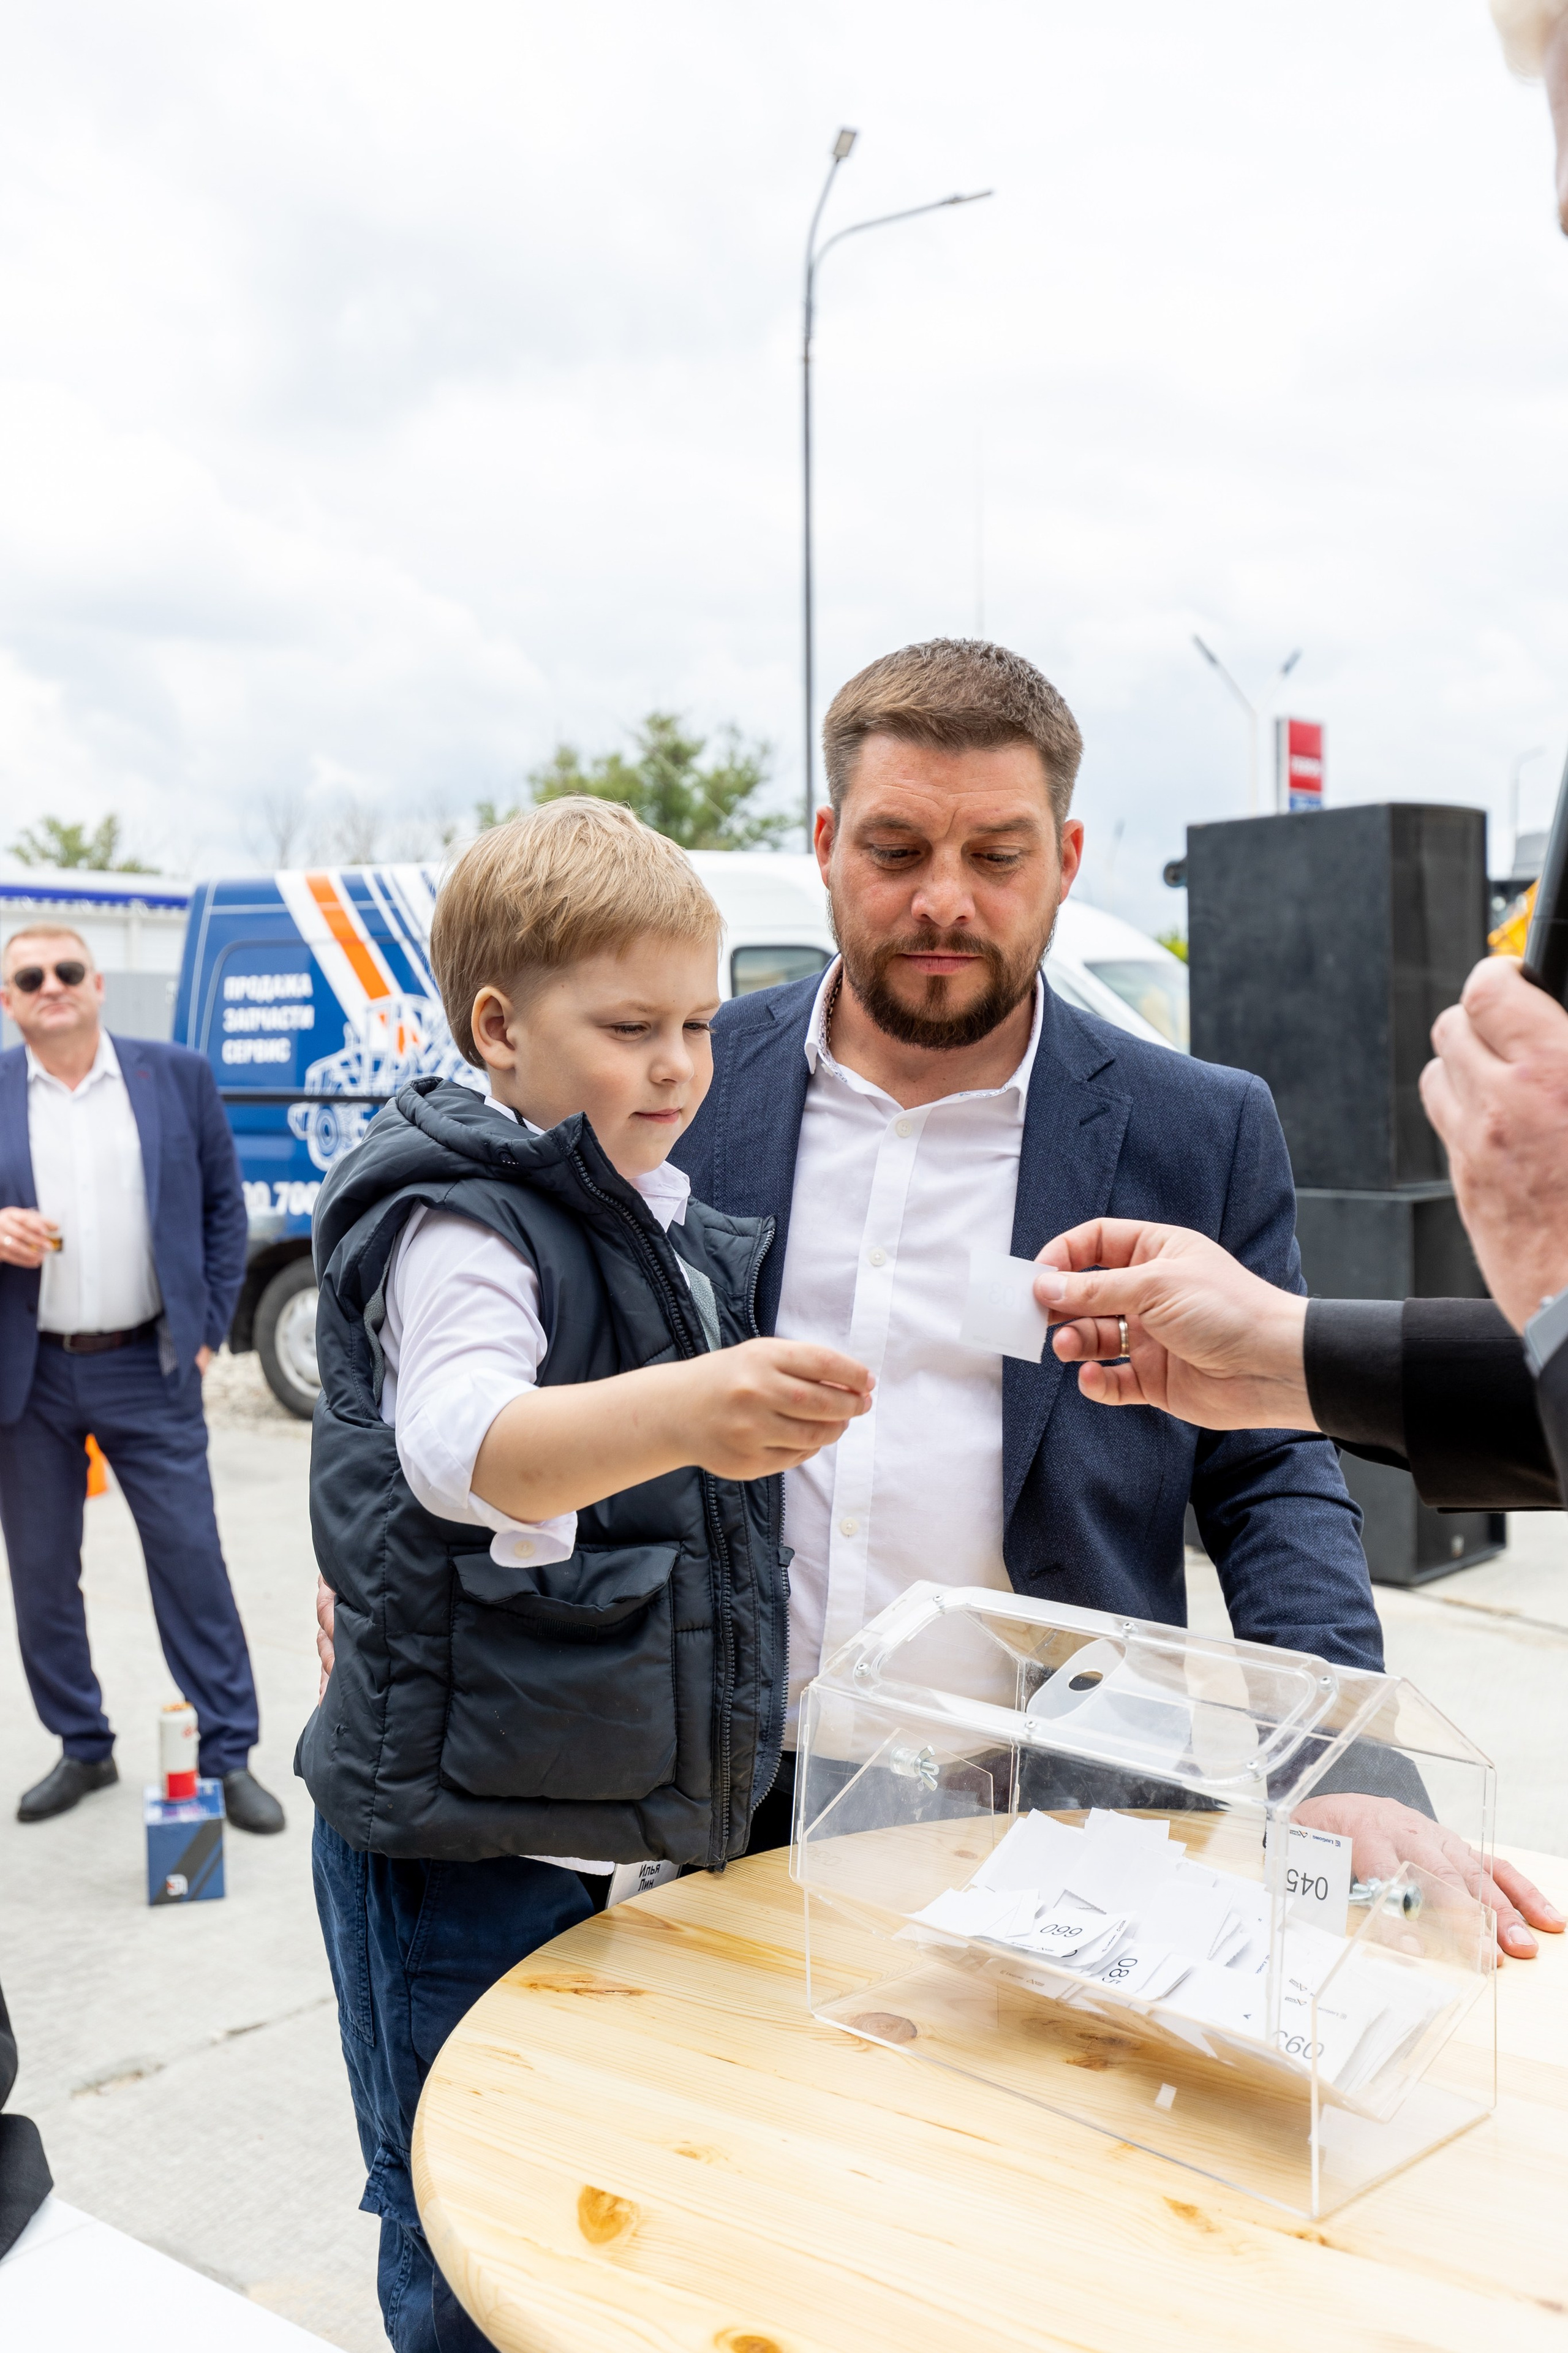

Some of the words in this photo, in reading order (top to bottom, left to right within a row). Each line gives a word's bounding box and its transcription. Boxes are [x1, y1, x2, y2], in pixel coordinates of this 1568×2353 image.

[222, 1005, 315, 1033] ЗАПЧАСТИ
[222, 1038, 291, 1065] СЕРВИС
[639, 1864, 661, 1878] Илья
[638, 1878, 655, 1892] Лин
[1286, 1868, 1328, 1901] 045
[1039, 1924, 1083, 1938] 099
[1102, 1958, 1138, 1984] 085
